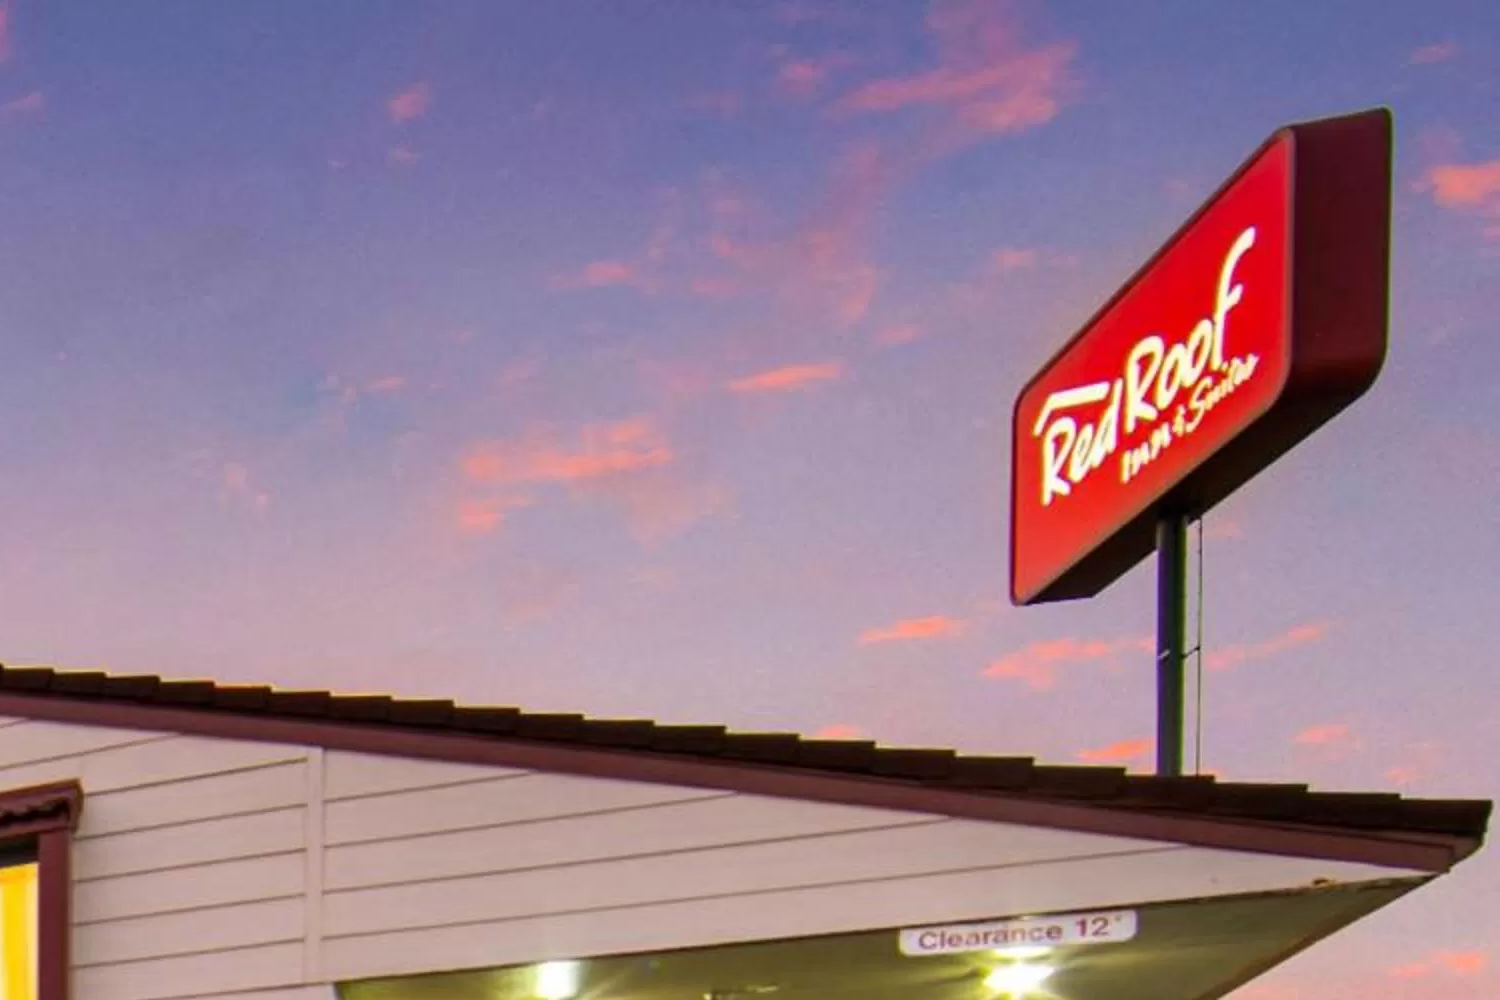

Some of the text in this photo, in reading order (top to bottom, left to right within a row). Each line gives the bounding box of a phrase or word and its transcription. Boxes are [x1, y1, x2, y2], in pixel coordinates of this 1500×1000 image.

[1040, 226, 1257, 506] Red Roof
[918, 923, 1063, 951] Clearance
